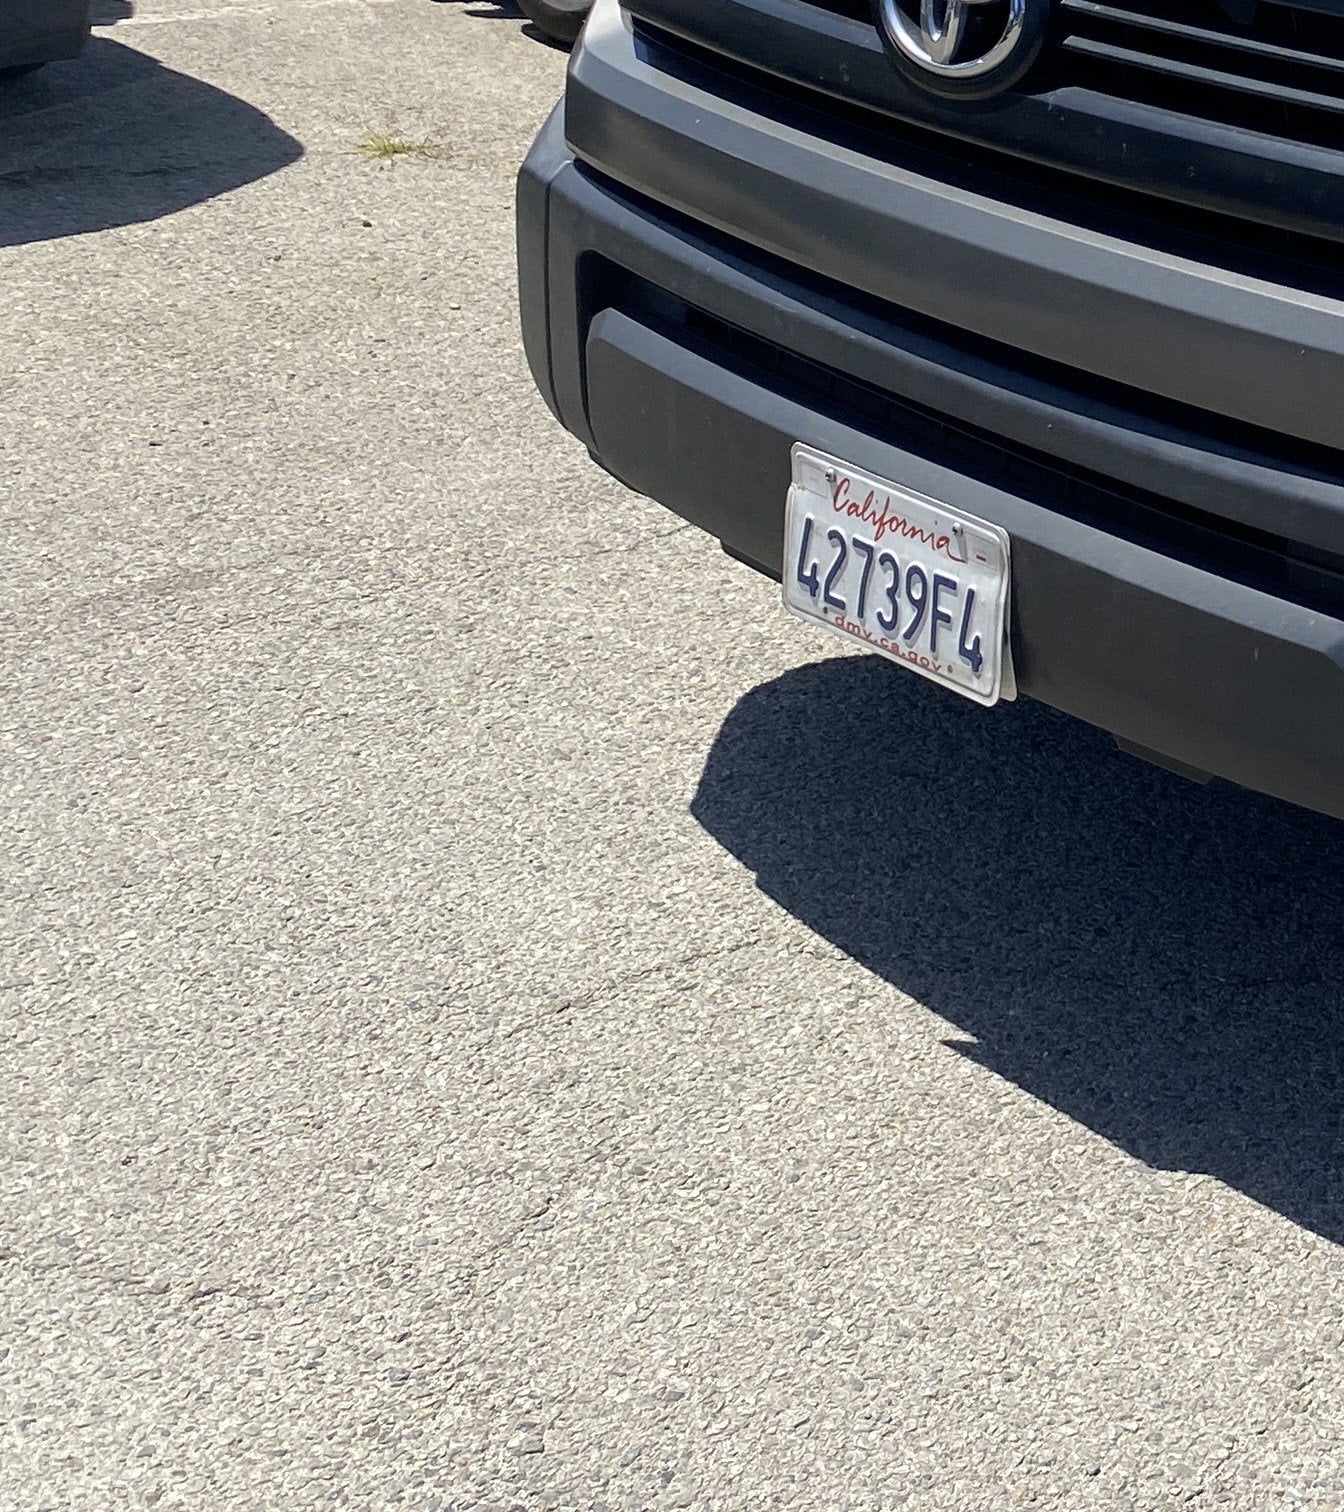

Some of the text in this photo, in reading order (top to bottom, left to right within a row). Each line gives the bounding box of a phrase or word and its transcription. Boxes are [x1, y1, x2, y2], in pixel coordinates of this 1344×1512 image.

[833, 477, 967, 564] California
[797, 517, 984, 674] 42739F4
[834, 615, 943, 673] dmv.ca.gov
